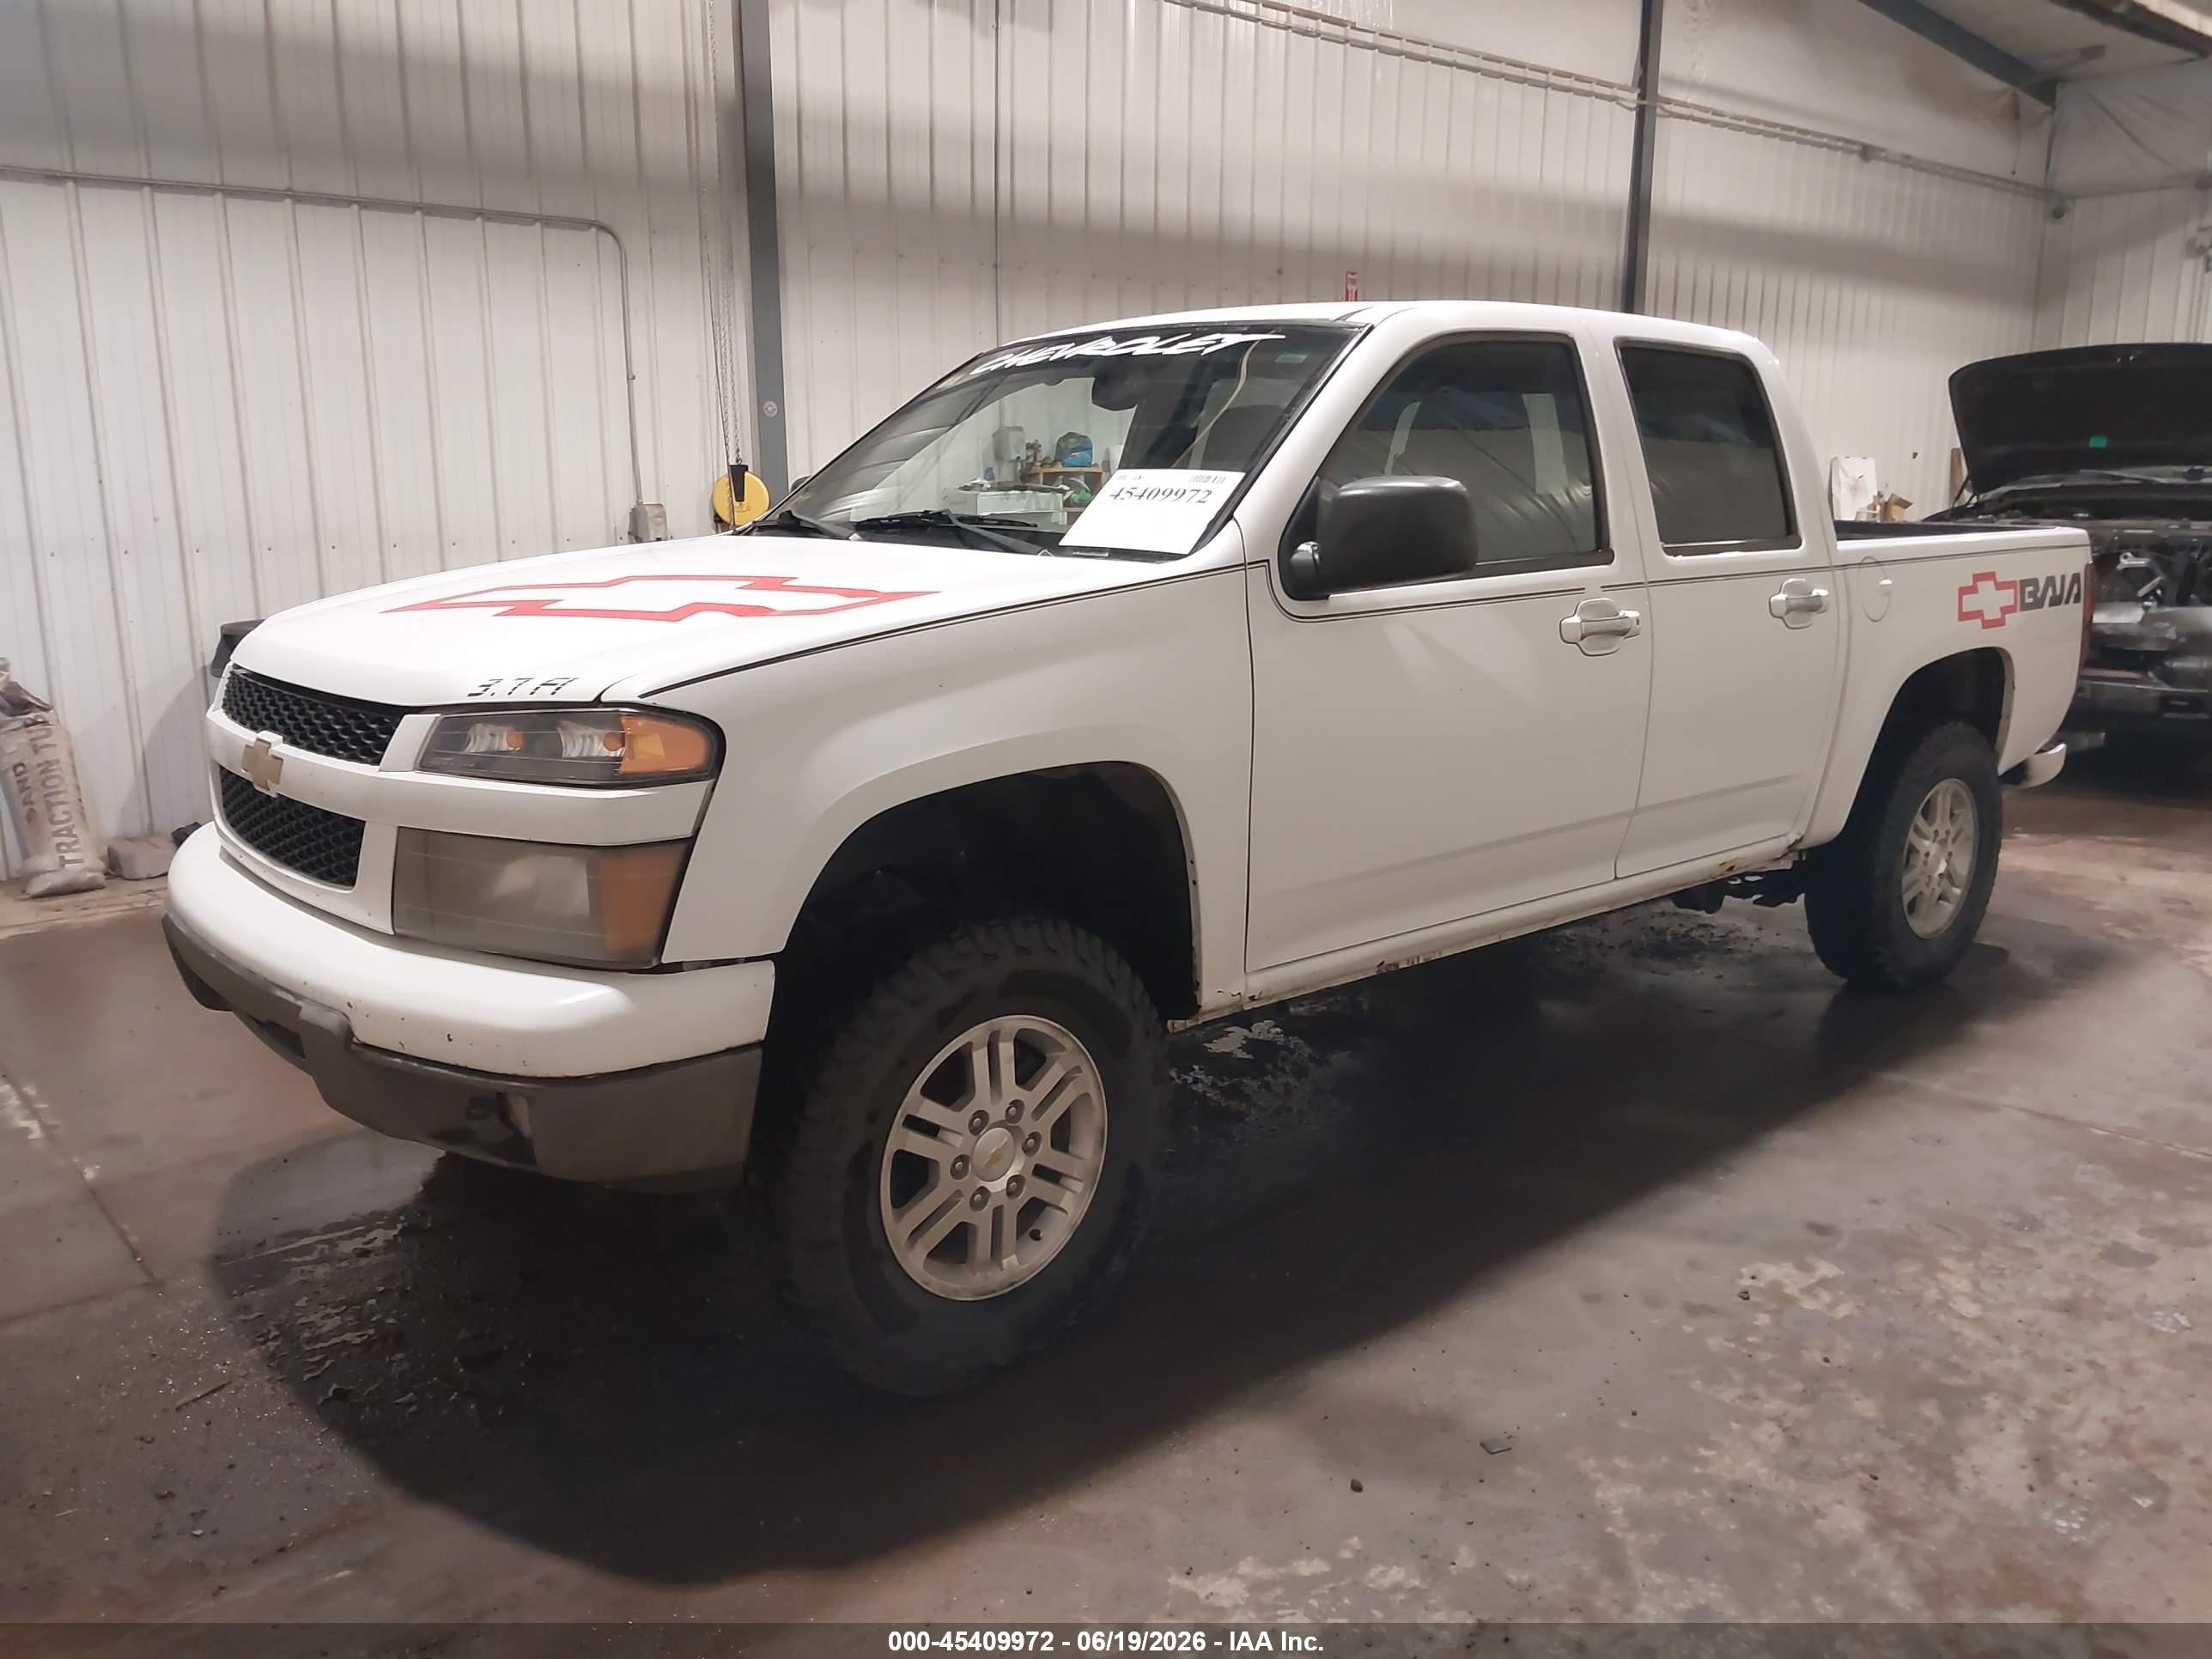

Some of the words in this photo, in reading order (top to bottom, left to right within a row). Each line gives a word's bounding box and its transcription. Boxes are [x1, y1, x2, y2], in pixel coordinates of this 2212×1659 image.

[969, 333, 1286, 375] CHEVROLET
[1109, 487, 1212, 503] 45409972
[2020, 573, 2081, 611] BAJA
[37, 758, 85, 868] TRACTION
